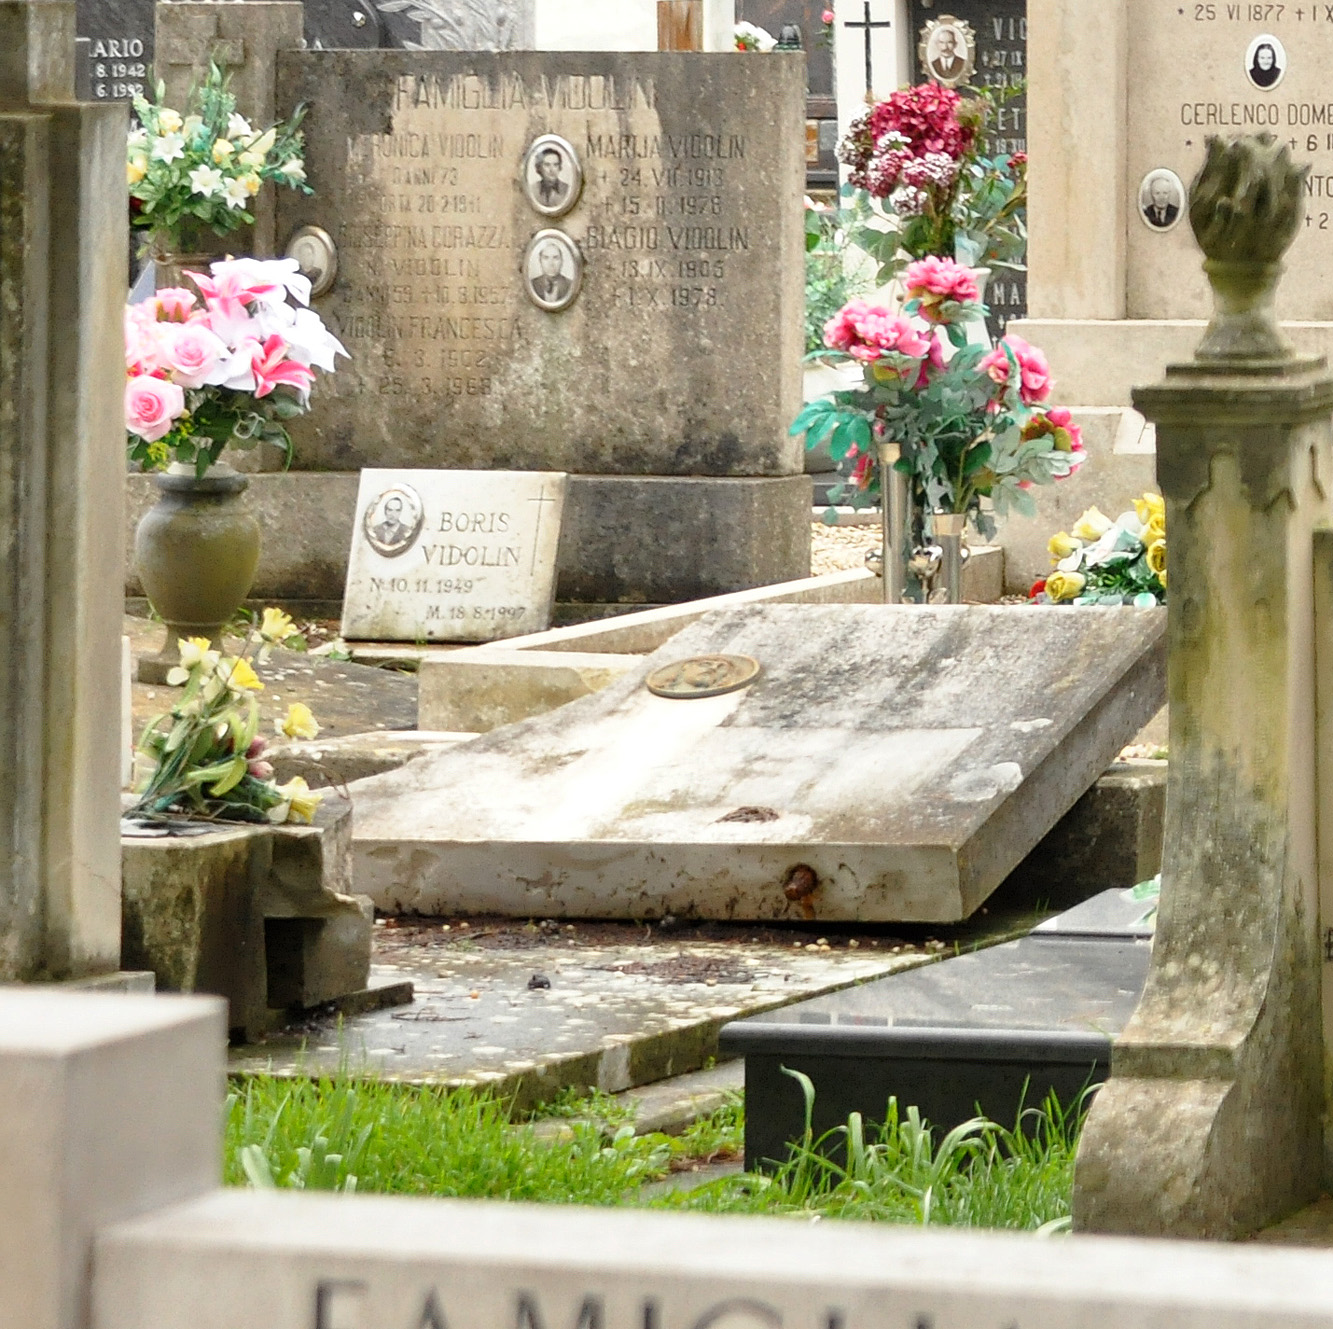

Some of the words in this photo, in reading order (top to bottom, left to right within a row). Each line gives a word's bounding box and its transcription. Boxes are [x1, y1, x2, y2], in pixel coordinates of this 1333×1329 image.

[1194, 4, 1216, 21] 25
[1226, 5, 1240, 21] VI
[1248, 4, 1285, 21] 1877
[111, 64, 146, 78] 1942
[1181, 103, 1279, 126] CERLENCO
[1306, 134, 1318, 151] 6
[1319, 212, 1328, 229] 2
[586, 226, 658, 250] BIAGIO
[666, 226, 749, 250] VIDOLIN
[438, 511, 511, 532] BORIS
[422, 544, 522, 566] VIDOLIN
